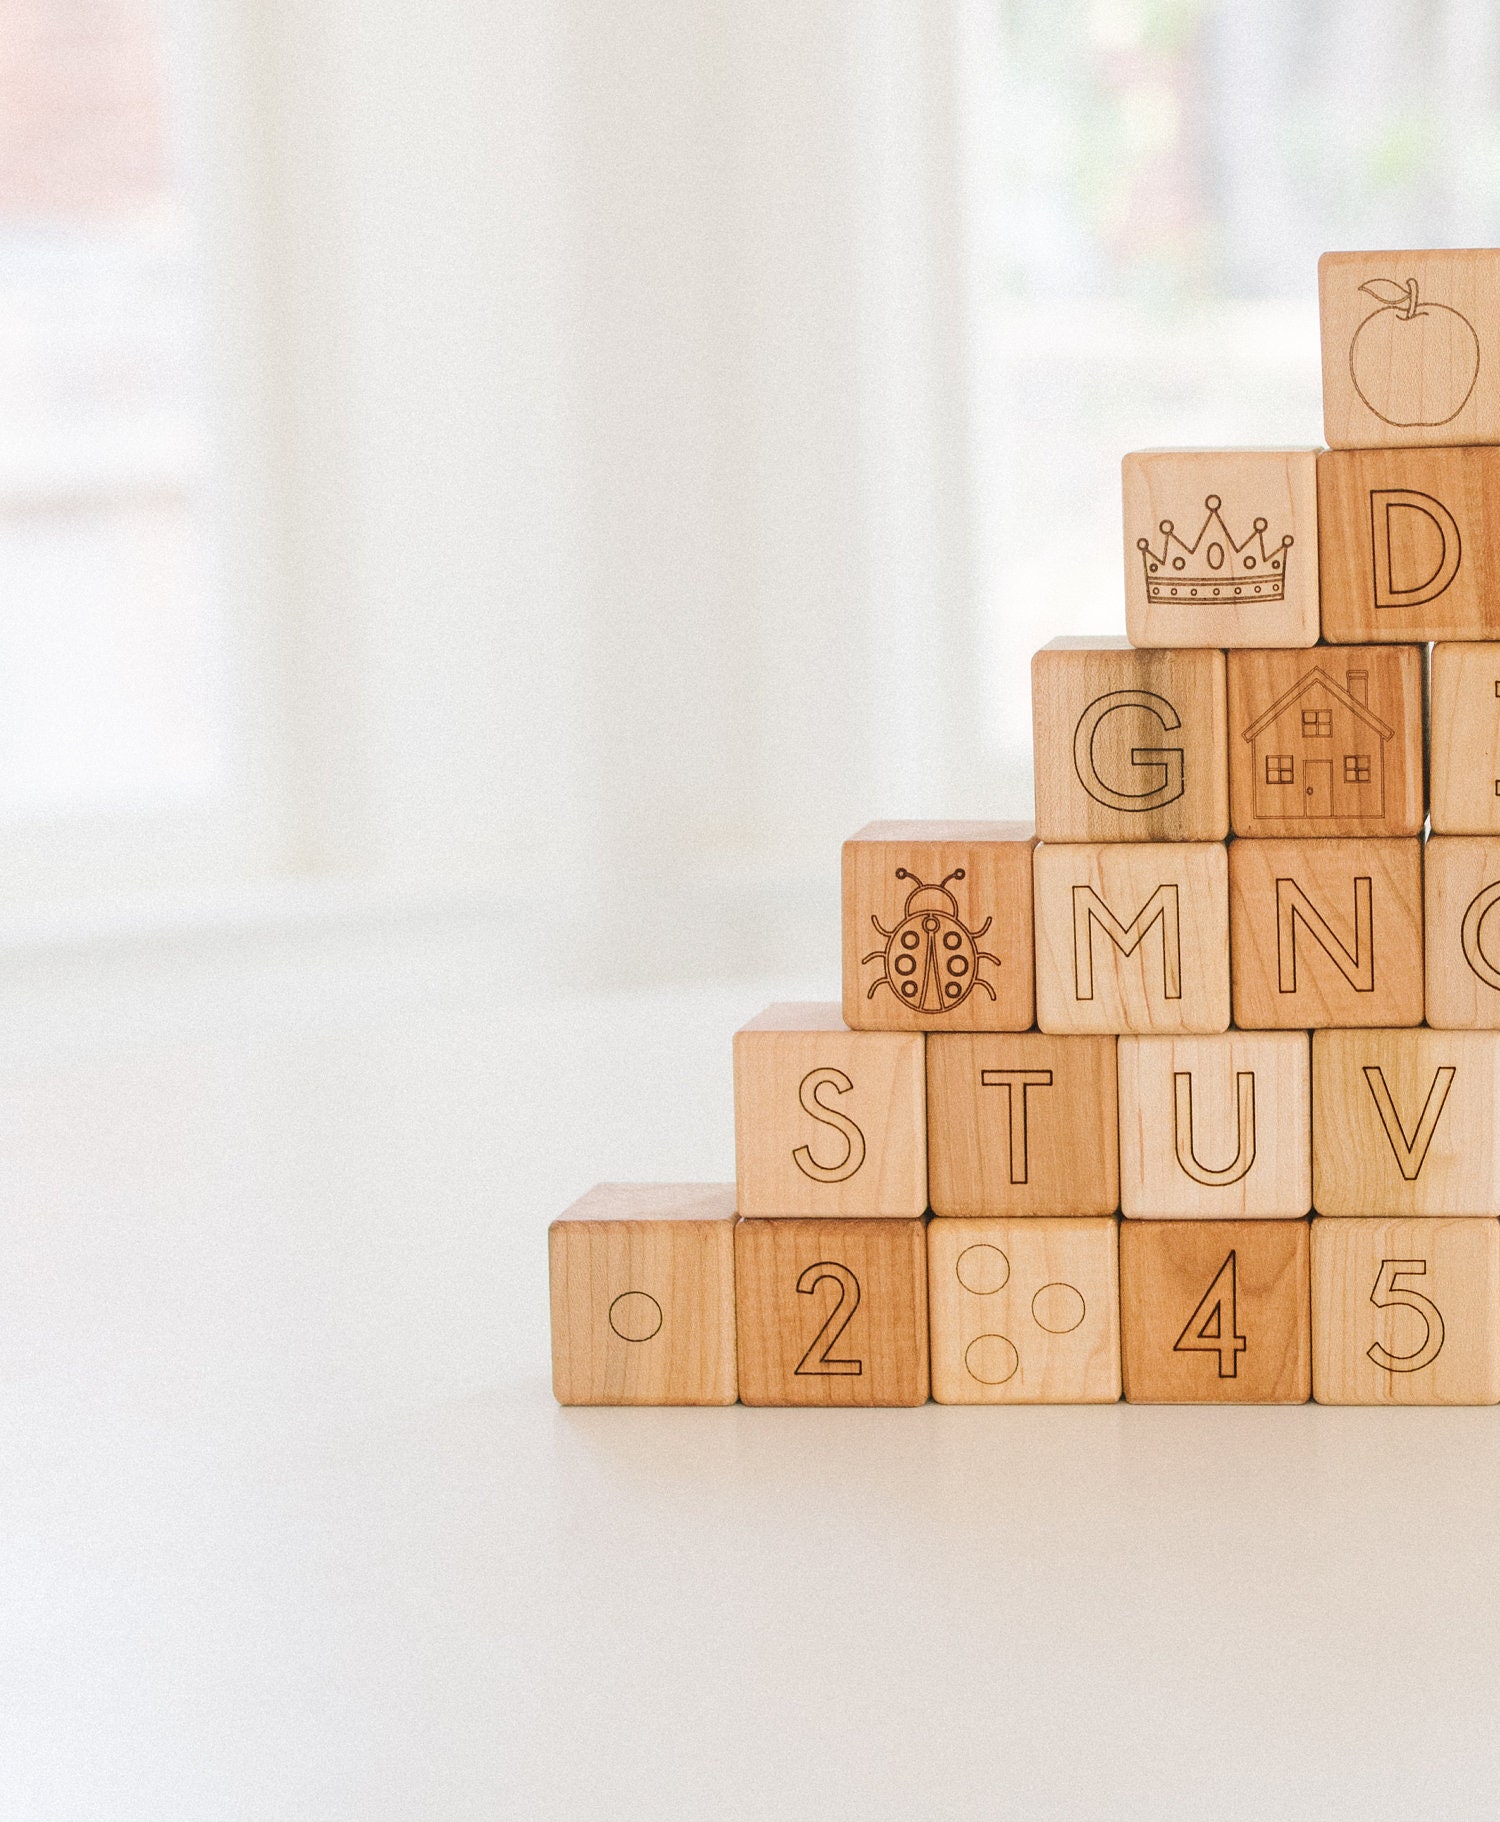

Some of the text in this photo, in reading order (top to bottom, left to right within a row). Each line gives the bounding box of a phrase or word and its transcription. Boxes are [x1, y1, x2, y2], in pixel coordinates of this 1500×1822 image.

[1371, 488, 1462, 609] D
[1073, 689, 1186, 813] G
[1071, 883, 1182, 1001] M
[1275, 876, 1375, 994] N
[791, 1065, 867, 1184] S
[980, 1068, 1054, 1185] T
[1173, 1070, 1257, 1187] U
[1362, 1065, 1456, 1182] V
[793, 1260, 863, 1376] 2
[1172, 1248, 1248, 1380] 4
[1365, 1259, 1445, 1373] 5
